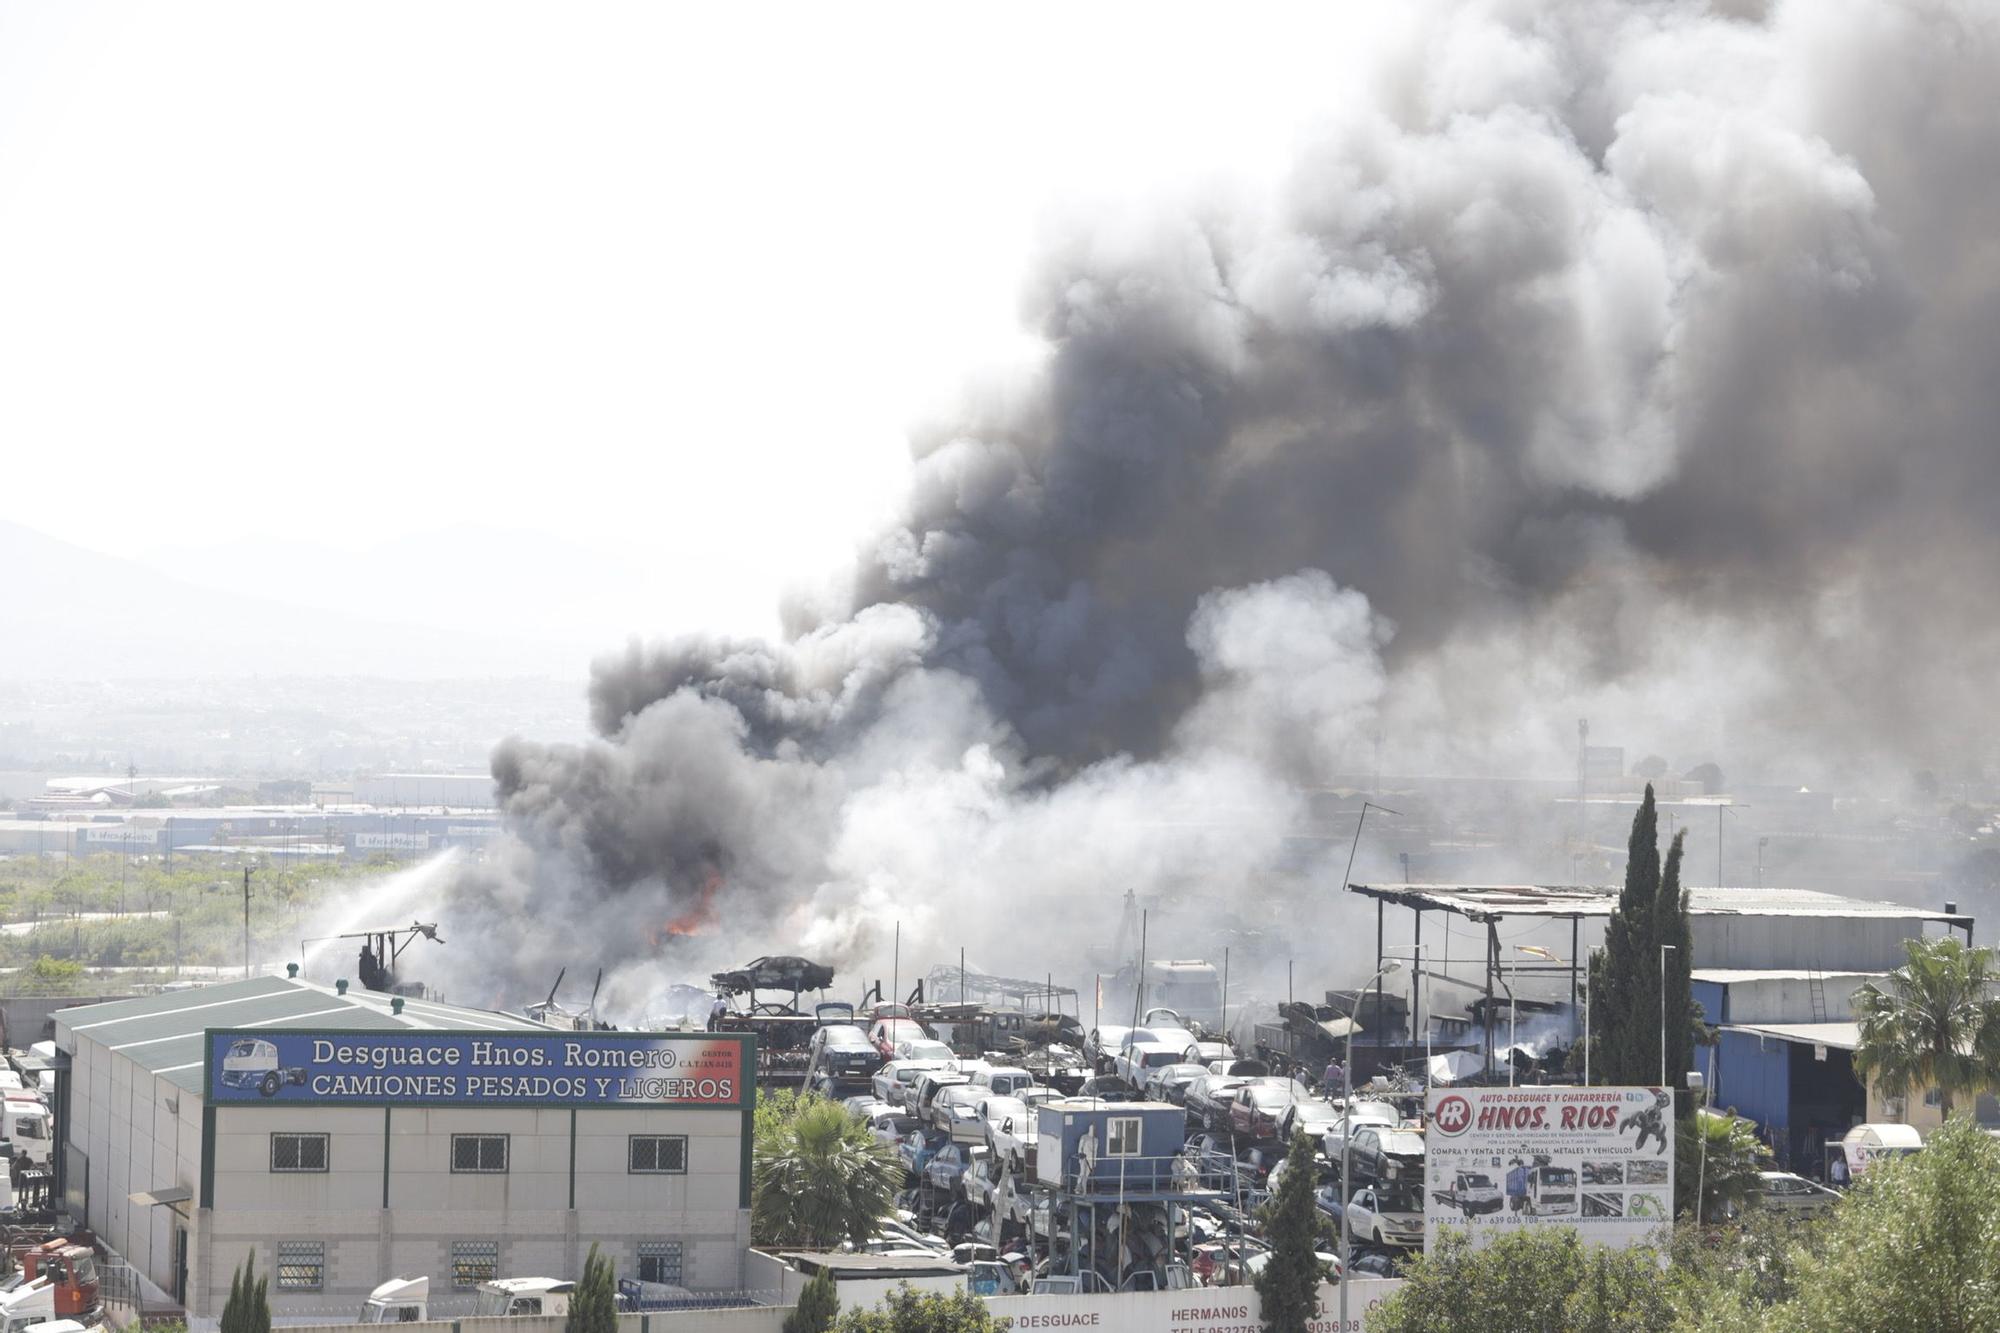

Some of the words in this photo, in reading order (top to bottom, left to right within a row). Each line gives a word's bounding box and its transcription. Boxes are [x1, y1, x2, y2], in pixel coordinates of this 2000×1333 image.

[313, 1040, 461, 1069] Desguace
[471, 1042, 552, 1066] Hnos.
[564, 1043, 677, 1069] Romero
[312, 1075, 457, 1096] CAMIONES
[466, 1076, 587, 1097] PESADOS
[594, 1077, 613, 1098] Y
[618, 1078, 733, 1099] LIGEROS
[1480, 1094, 1551, 1102] AUTO-DESGUACE
[1553, 1093, 1561, 1103] Y
[1478, 1106, 1551, 1130] HNOS.
[1560, 1106, 1619, 1130] RIOS
[1431, 1147, 1462, 1155] COMPRA
[1464, 1147, 1468, 1155] Y
[1471, 1147, 1494, 1155] VENTA
[1496, 1147, 1505, 1155] DE
[1430, 1216, 1445, 1224] 952
[1447, 1216, 1457, 1224] 27
[1489, 1216, 1504, 1224] 639
[1506, 1216, 1522, 1224] 036
[1524, 1216, 1539, 1224] 108
